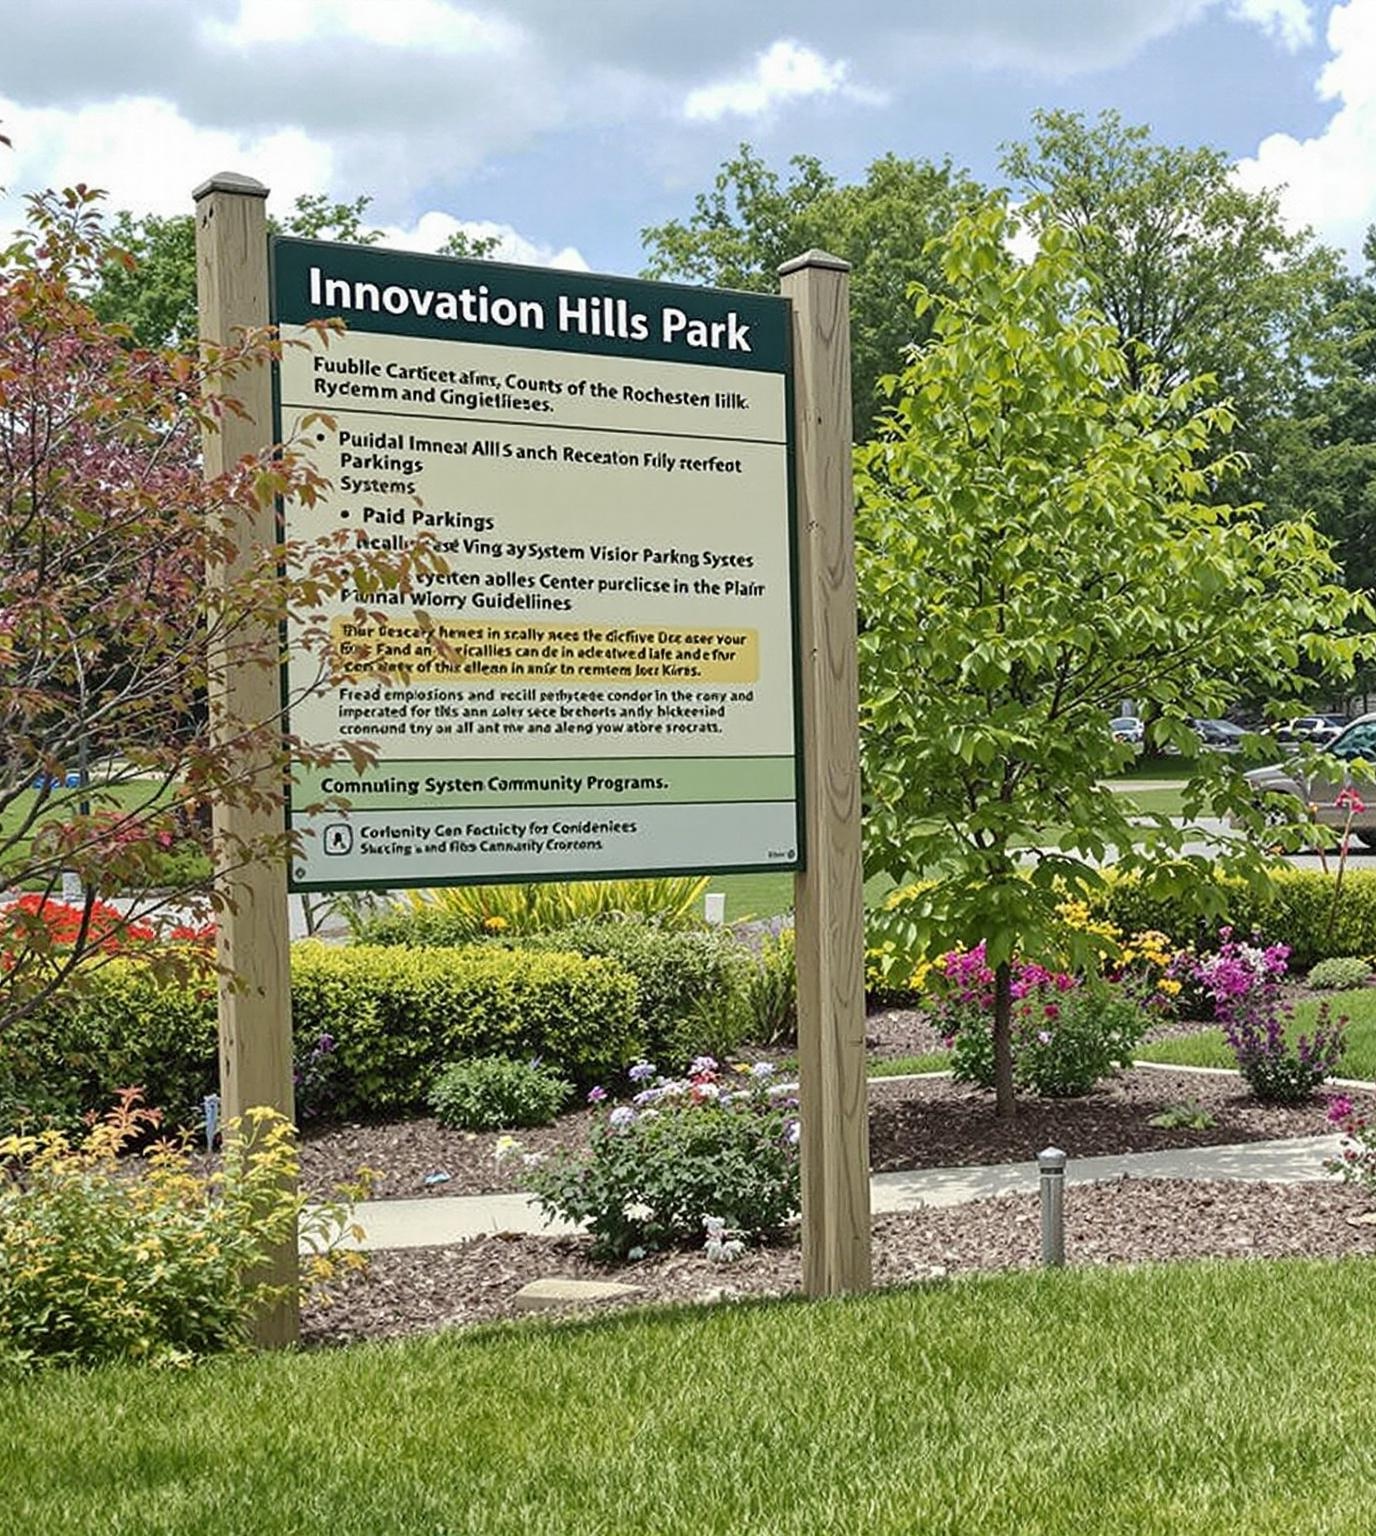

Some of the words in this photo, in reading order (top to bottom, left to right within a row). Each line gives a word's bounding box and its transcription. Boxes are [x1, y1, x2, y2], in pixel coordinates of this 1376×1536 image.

[309, 267, 544, 330] Innovation
[558, 295, 649, 341] Hills
[662, 307, 752, 353] Park
[402, 387, 435, 403] and
[567, 380, 587, 396] of
[591, 383, 618, 399] the
[340, 453, 424, 475] Parkings
[340, 475, 416, 494] Systems
[363, 507, 405, 525] Paid
[412, 510, 495, 532] Parkings
[463, 538, 502, 557] Ving
[540, 574, 594, 590] Center
[674, 579, 689, 594] in
[694, 579, 720, 595] the
[487, 627, 501, 640] in
[716, 634, 747, 646] your
[515, 647, 539, 658] can
[562, 646, 574, 659] in
[417, 660, 432, 673] of
[511, 662, 524, 674] in
[468, 689, 494, 702] and
[656, 690, 668, 702] in
[671, 690, 693, 702] the
[730, 690, 754, 702] and
[411, 705, 431, 718] for
[587, 775, 669, 793] Programs.
